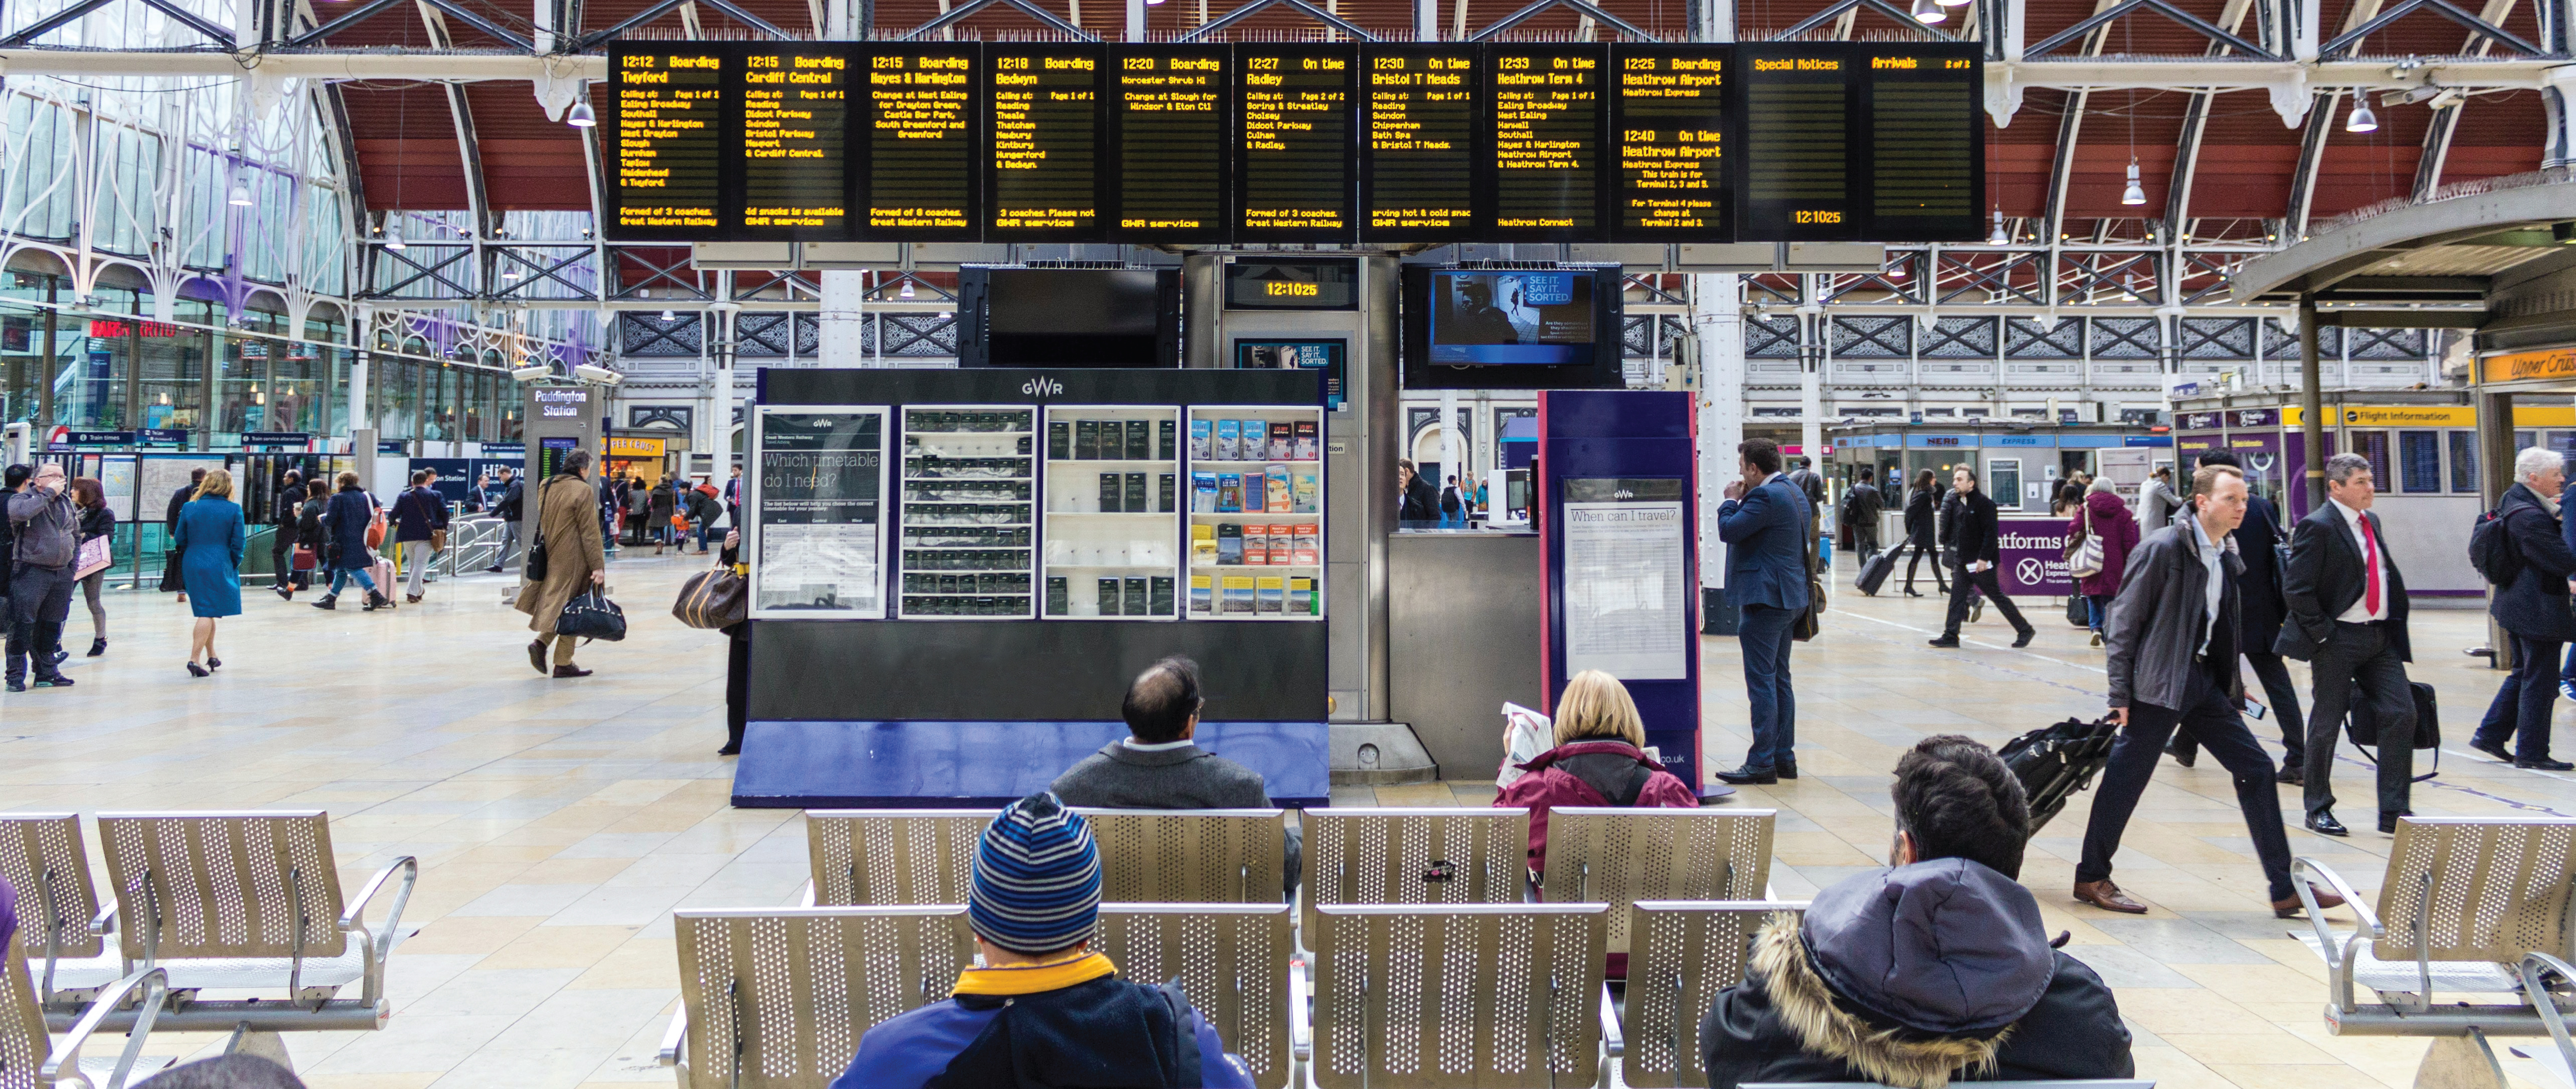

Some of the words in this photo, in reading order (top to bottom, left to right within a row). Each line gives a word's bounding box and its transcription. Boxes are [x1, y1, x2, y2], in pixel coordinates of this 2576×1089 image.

[623, 56, 654, 68] 12:12
[670, 56, 719, 70] Boarding
[748, 56, 779, 68] 12:15
[795, 57, 844, 70] Boarding
[873, 57, 903, 68] 12:15
[920, 57, 969, 70] Boarding
[998, 58, 1028, 69] 12:18
[1045, 58, 1094, 71] Boarding
[1124, 59, 1154, 69] 12:20
[1171, 59, 1219, 71] Boarding
[1249, 58, 1279, 69] 12:27
[1303, 58, 1317, 69] On
[1322, 59, 1345, 69] time
[1375, 58, 1404, 69] 12:30
[1429, 58, 1443, 69] On
[1448, 58, 1470, 69] time
[1500, 58, 1529, 69] 12:33
[1554, 58, 1568, 69] On
[1573, 58, 1595, 69] time
[1625, 59, 1655, 70] 12:25
[1672, 59, 1721, 71] Boarding
[1755, 59, 1793, 71] Special
[1798, 59, 1839, 70] Notices
[1872, 57, 1917, 69] Arrivals
[621, 71, 668, 84] Twyford
[746, 72, 785, 83] Cardiff
[790, 72, 831, 83] Central
[871, 72, 902, 85] Hayes
[915, 73, 967, 85] Harlington
[996, 73, 1037, 86] Bedwyn
[1248, 74, 1283, 86] Radley
[1373, 74, 1410, 84] Bristol
[1427, 74, 1460, 85] Meads
[1498, 73, 1544, 84] Heathrow
[1548, 73, 1573, 84] Term
[1576, 73, 1583, 84] 4
[1624, 74, 1676, 85] Heathrow
[1680, 74, 1722, 87] Airport
[1125, 93, 1155, 101] Change
[1171, 93, 1199, 102] Slough
[621, 100, 649, 109] Ealing
[651, 101, 691, 109] Broadway
[746, 110, 774, 118] Didcot
[777, 110, 812, 119] Parkway
[1373, 122, 1420, 130] Chippenham
[1625, 131, 1655, 141] 12:40
[1679, 131, 1693, 142] On
[1698, 131, 1721, 142] time
[1624, 146, 1676, 157] Heathrow
[1680, 146, 1721, 159] Airport
[1665, 161, 1699, 169] Express
[621, 169, 670, 177] Maidenhead
[1540, 218, 1574, 226] Connect
[1796, 211, 1841, 223] 12:1025
[2547, 354, 2576, 373] Crus
[1022, 376, 1063, 397] GWR
[535, 390, 586, 404] Paddington
[543, 406, 577, 417] Station
[2360, 412, 2388, 421] Flight
[2390, 411, 2450, 421] Information
[813, 419, 832, 428] GWR
[1927, 437, 1959, 446] NERO
[765, 454, 808, 467] Which
[813, 454, 878, 467] timetable
[765, 474, 782, 487] do
[786, 474, 791, 487] I
[795, 473, 836, 487] need?
[1614, 489, 1633, 499] GWR
[1571, 511, 1603, 522] When
[1607, 512, 1628, 521] can
[1631, 511, 1635, 521] I
[1638, 510, 1675, 521] travel?
[1997, 532, 2062, 549] atforms
[2045, 560, 2069, 569] Heat
